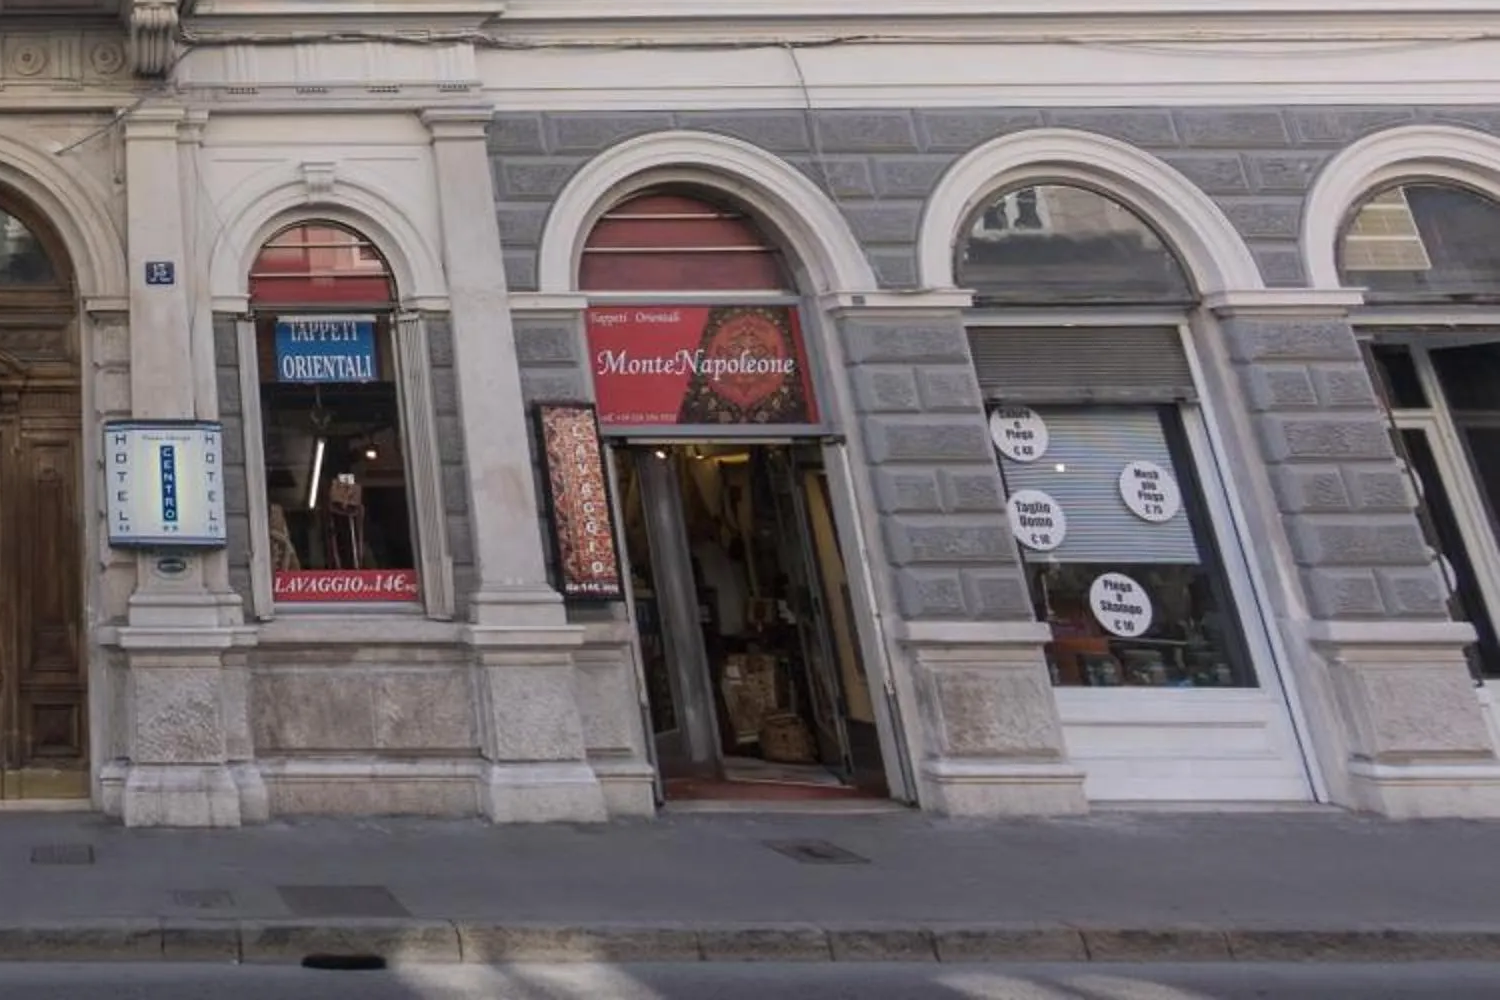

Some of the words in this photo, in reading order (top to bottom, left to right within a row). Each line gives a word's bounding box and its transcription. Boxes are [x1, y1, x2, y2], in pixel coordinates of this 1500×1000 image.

[290, 319, 358, 341] TAPPETI
[281, 353, 373, 379] ORIENTALI
[596, 348, 795, 381] MonteNapoleone
[115, 433, 129, 522] HOTEL
[162, 447, 176, 519] CENTRO
[204, 433, 218, 522] HOTEL
[1013, 500, 1051, 514] Taglio
[275, 576, 363, 592] LAVAGGIO
